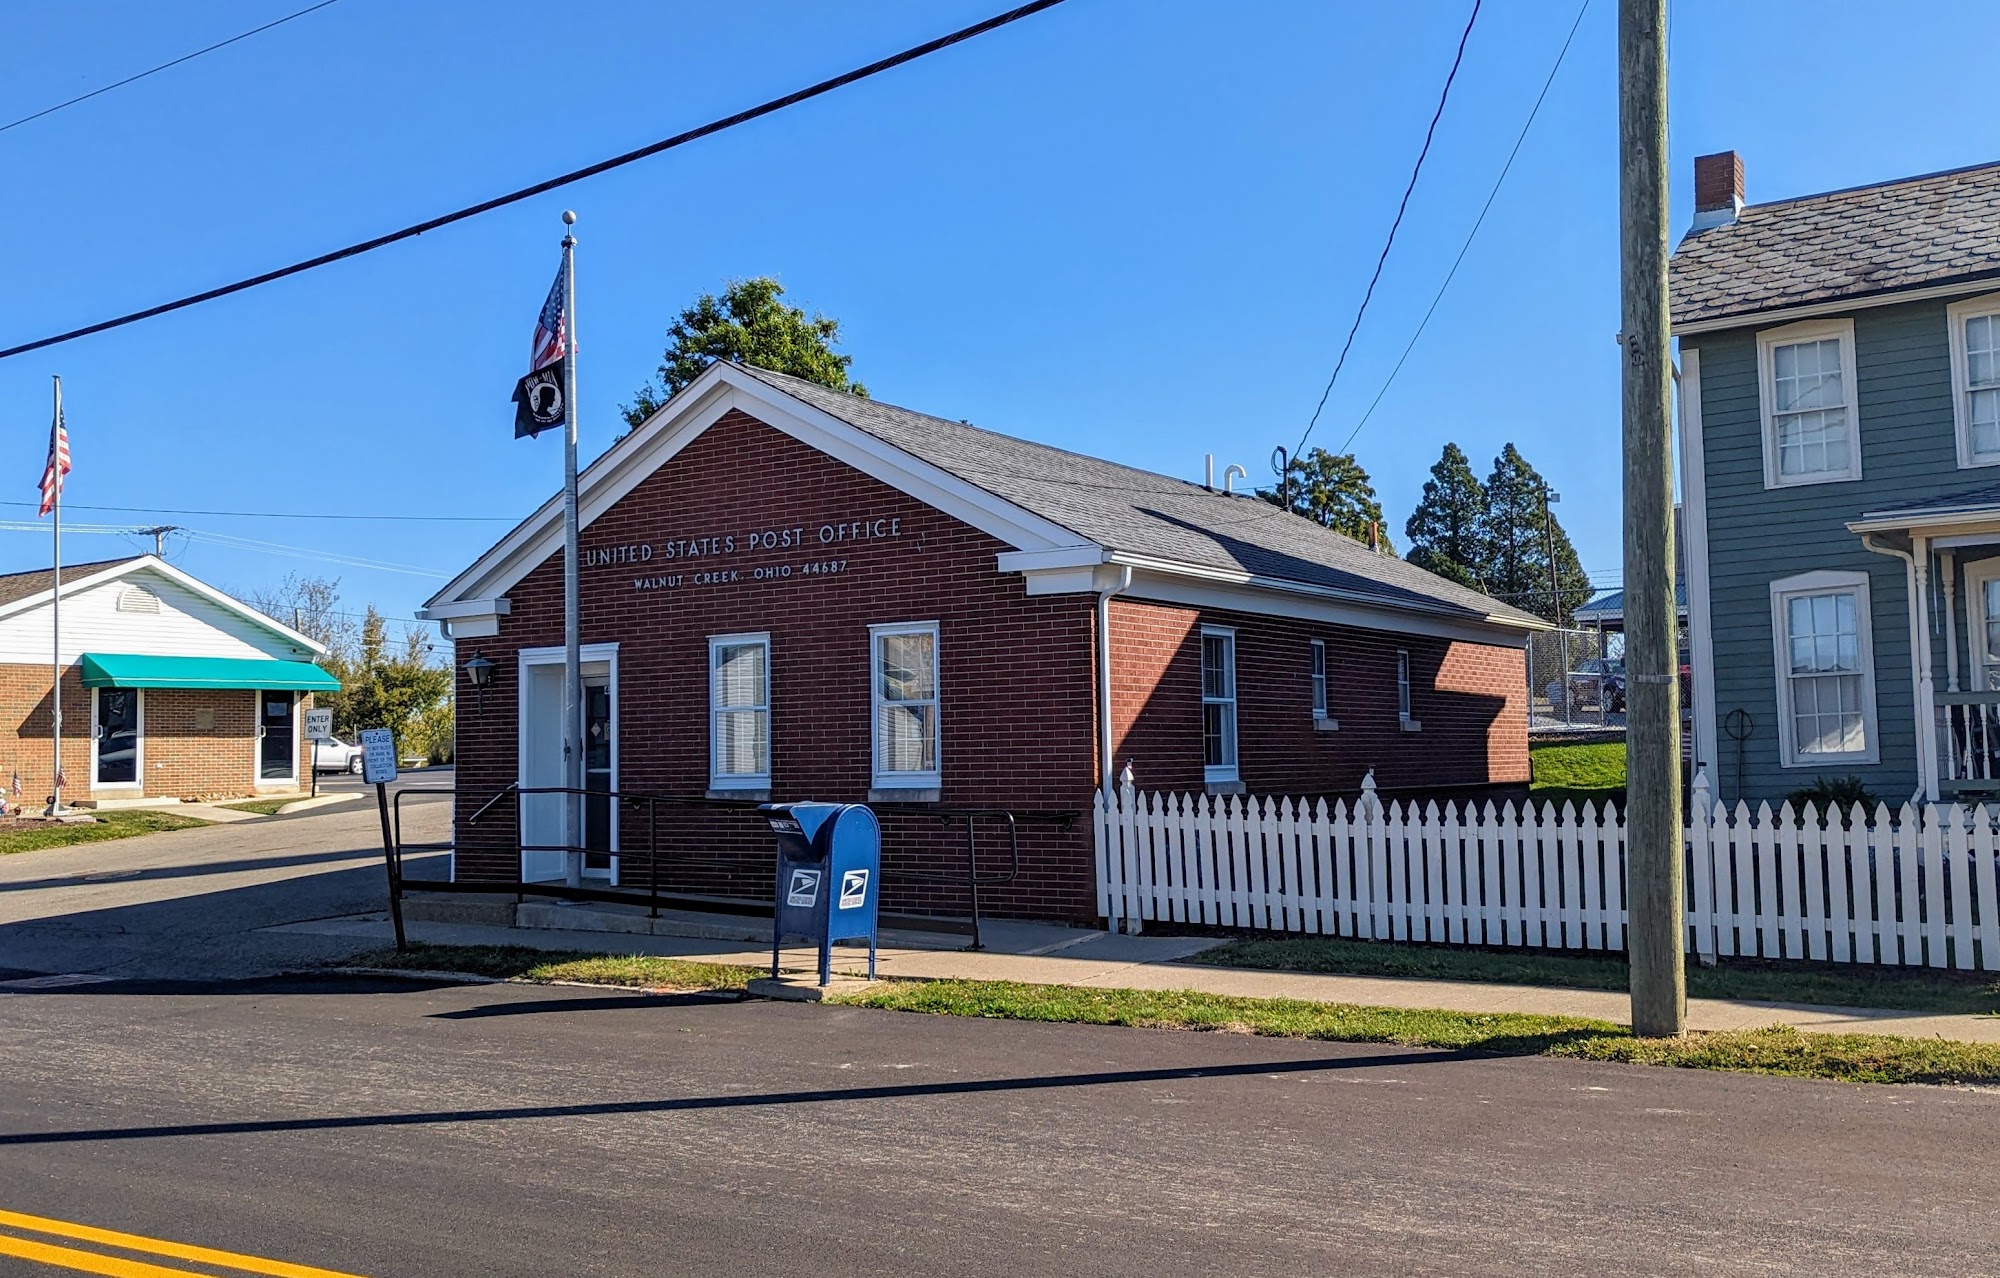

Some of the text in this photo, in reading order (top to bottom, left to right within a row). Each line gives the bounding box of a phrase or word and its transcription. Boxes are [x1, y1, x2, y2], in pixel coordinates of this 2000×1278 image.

[586, 518, 902, 566] UNITED STATES POST OFFICE
[634, 575, 683, 590] WALNUT
[754, 565, 791, 579] OHIO
[802, 560, 847, 575] 44687
[307, 715, 329, 723] ENTER
[366, 735, 390, 743] PLEASE
